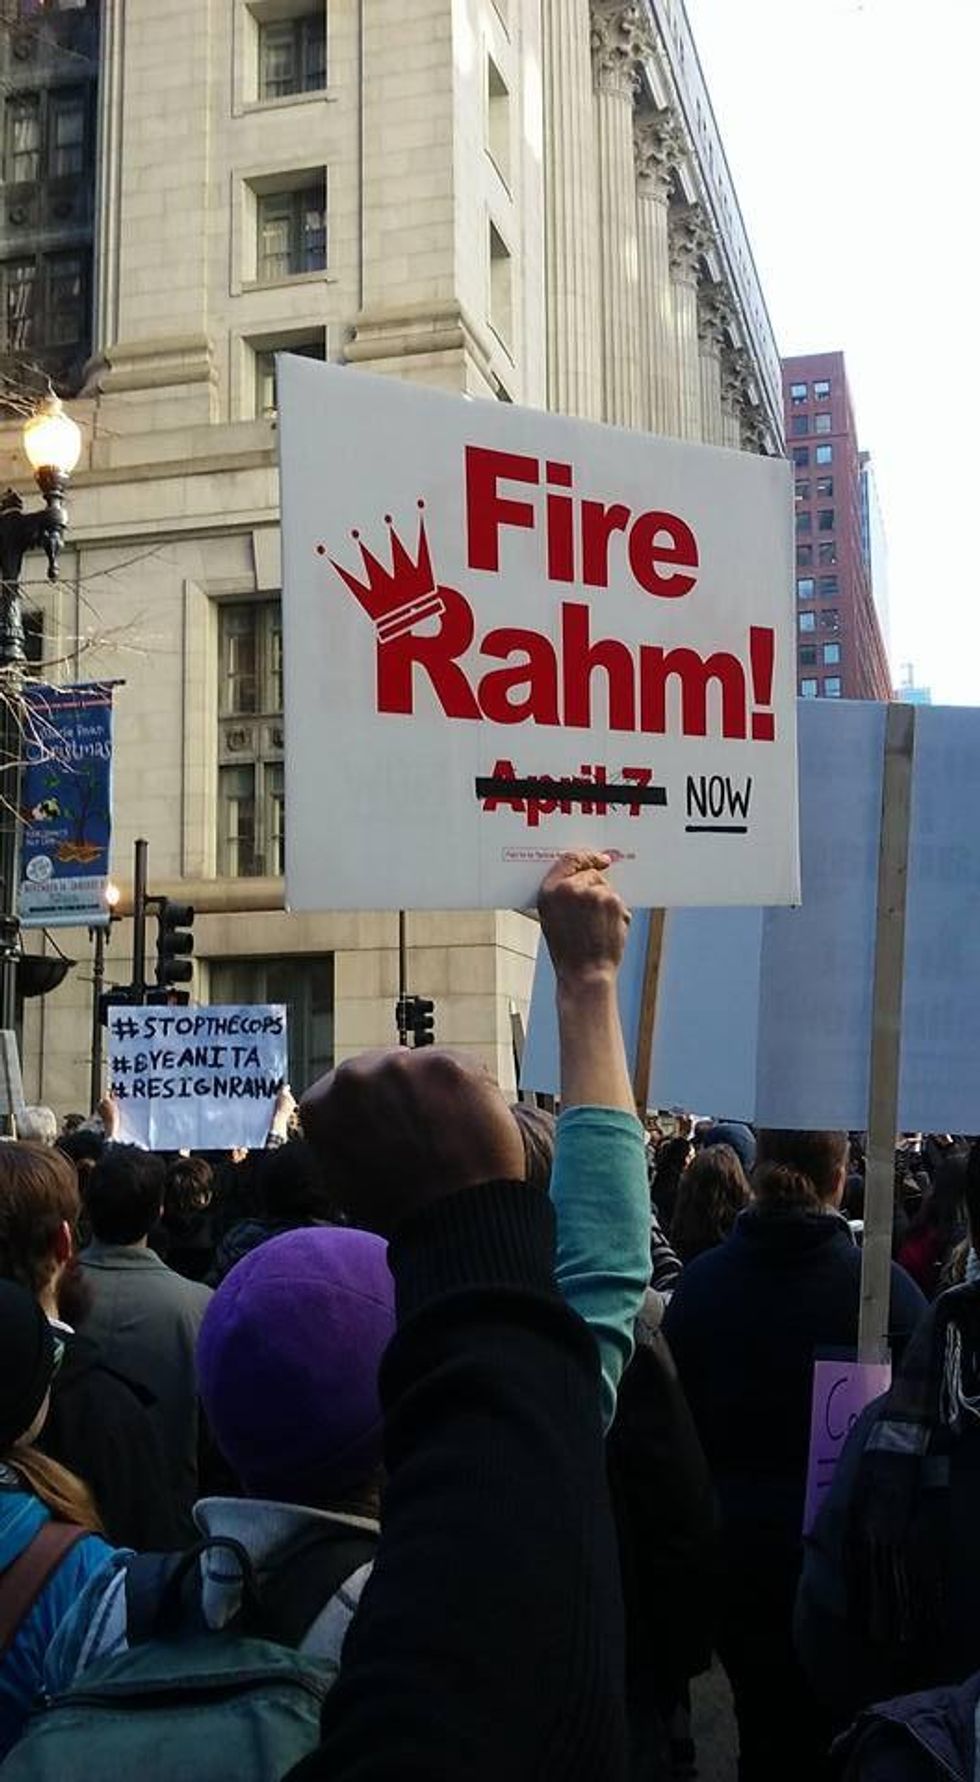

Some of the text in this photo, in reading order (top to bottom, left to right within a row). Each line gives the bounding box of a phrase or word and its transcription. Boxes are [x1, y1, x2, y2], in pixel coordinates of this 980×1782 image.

[465, 445, 700, 599] Fire
[376, 585, 776, 742] Rahm!
[483, 760, 652, 826] April 7
[687, 776, 752, 818] NOW
[112, 1016, 284, 1041] #STOPTHECOPS
[112, 1046, 261, 1074] #BYEANITA
